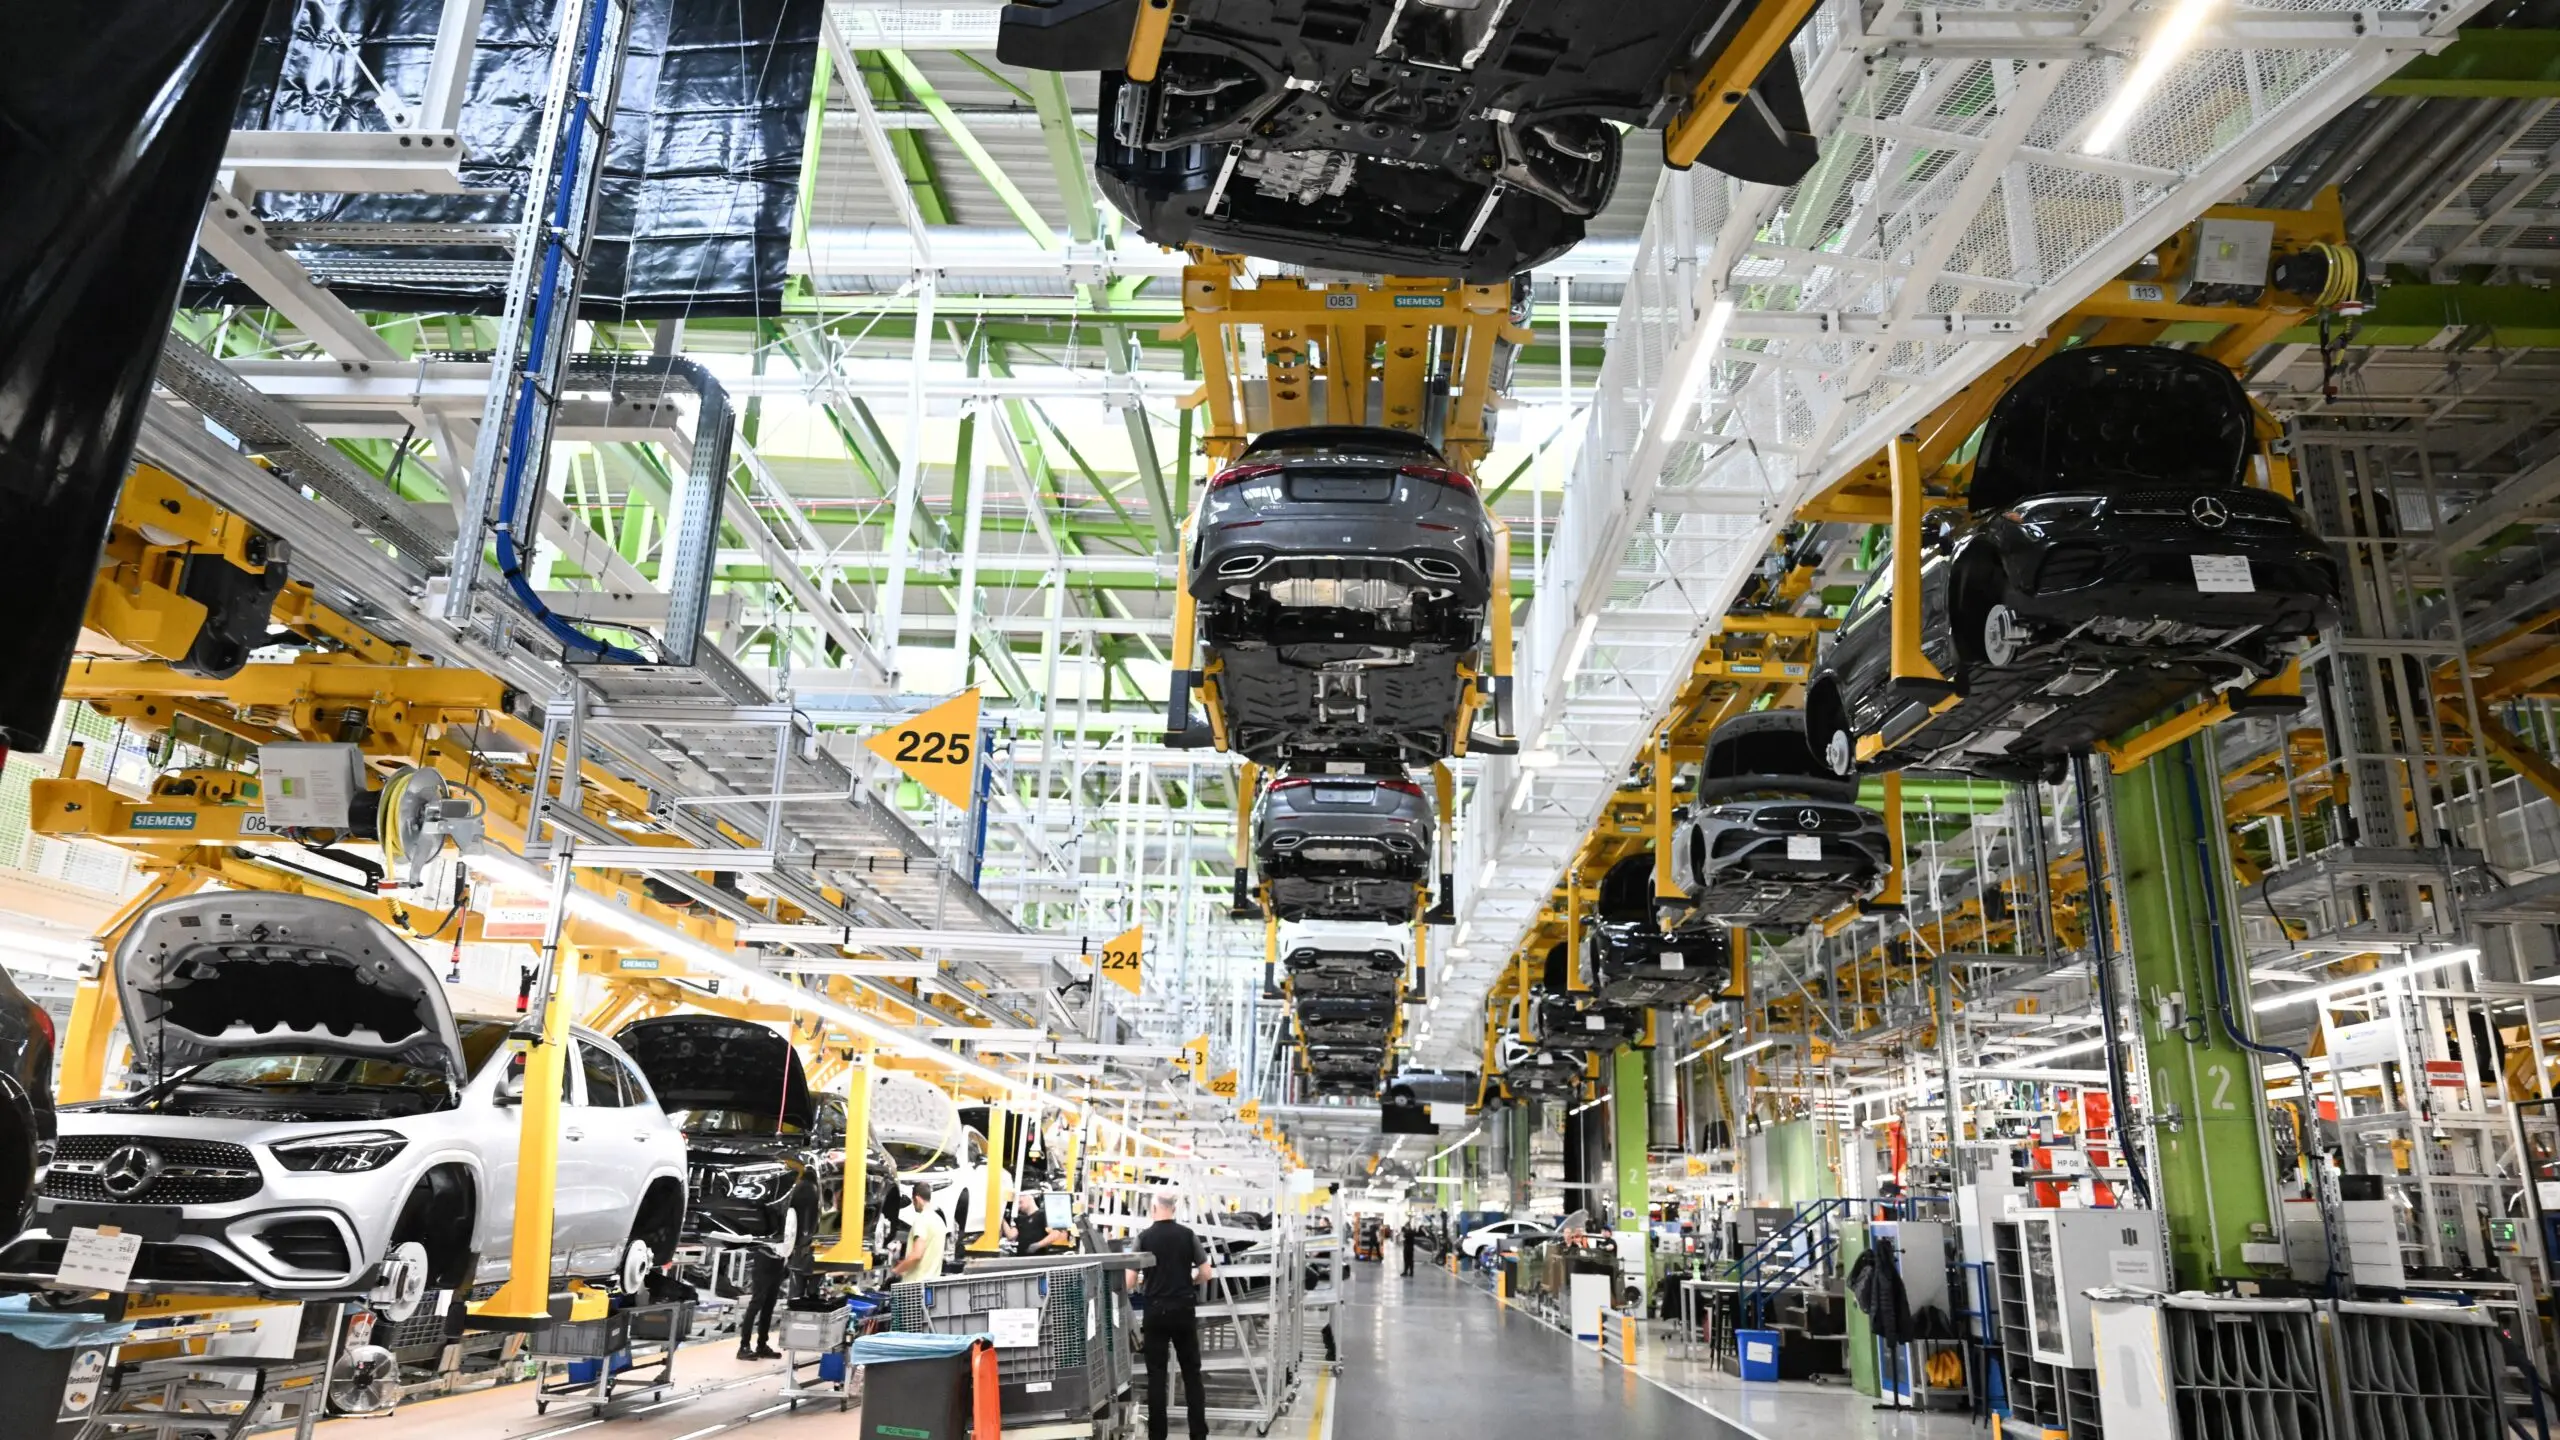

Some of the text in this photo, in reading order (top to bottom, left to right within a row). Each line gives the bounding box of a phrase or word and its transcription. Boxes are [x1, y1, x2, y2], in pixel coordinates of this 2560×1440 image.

[2135, 287, 2157, 299] 113
[1330, 295, 1353, 307] 083
[1396, 297, 1442, 306] SIEMENS
[895, 730, 970, 765] 225
[134, 814, 193, 827] SIEMENS
[246, 815, 270, 831] 08
[1102, 951, 1139, 970] 224
[1213, 1081, 1236, 1093] 222
[2207, 1064, 2236, 1111] 2
[1240, 1109, 1257, 1118] 221
[2057, 1159, 2067, 1168] HP
[1628, 1168, 1639, 1185] 2
